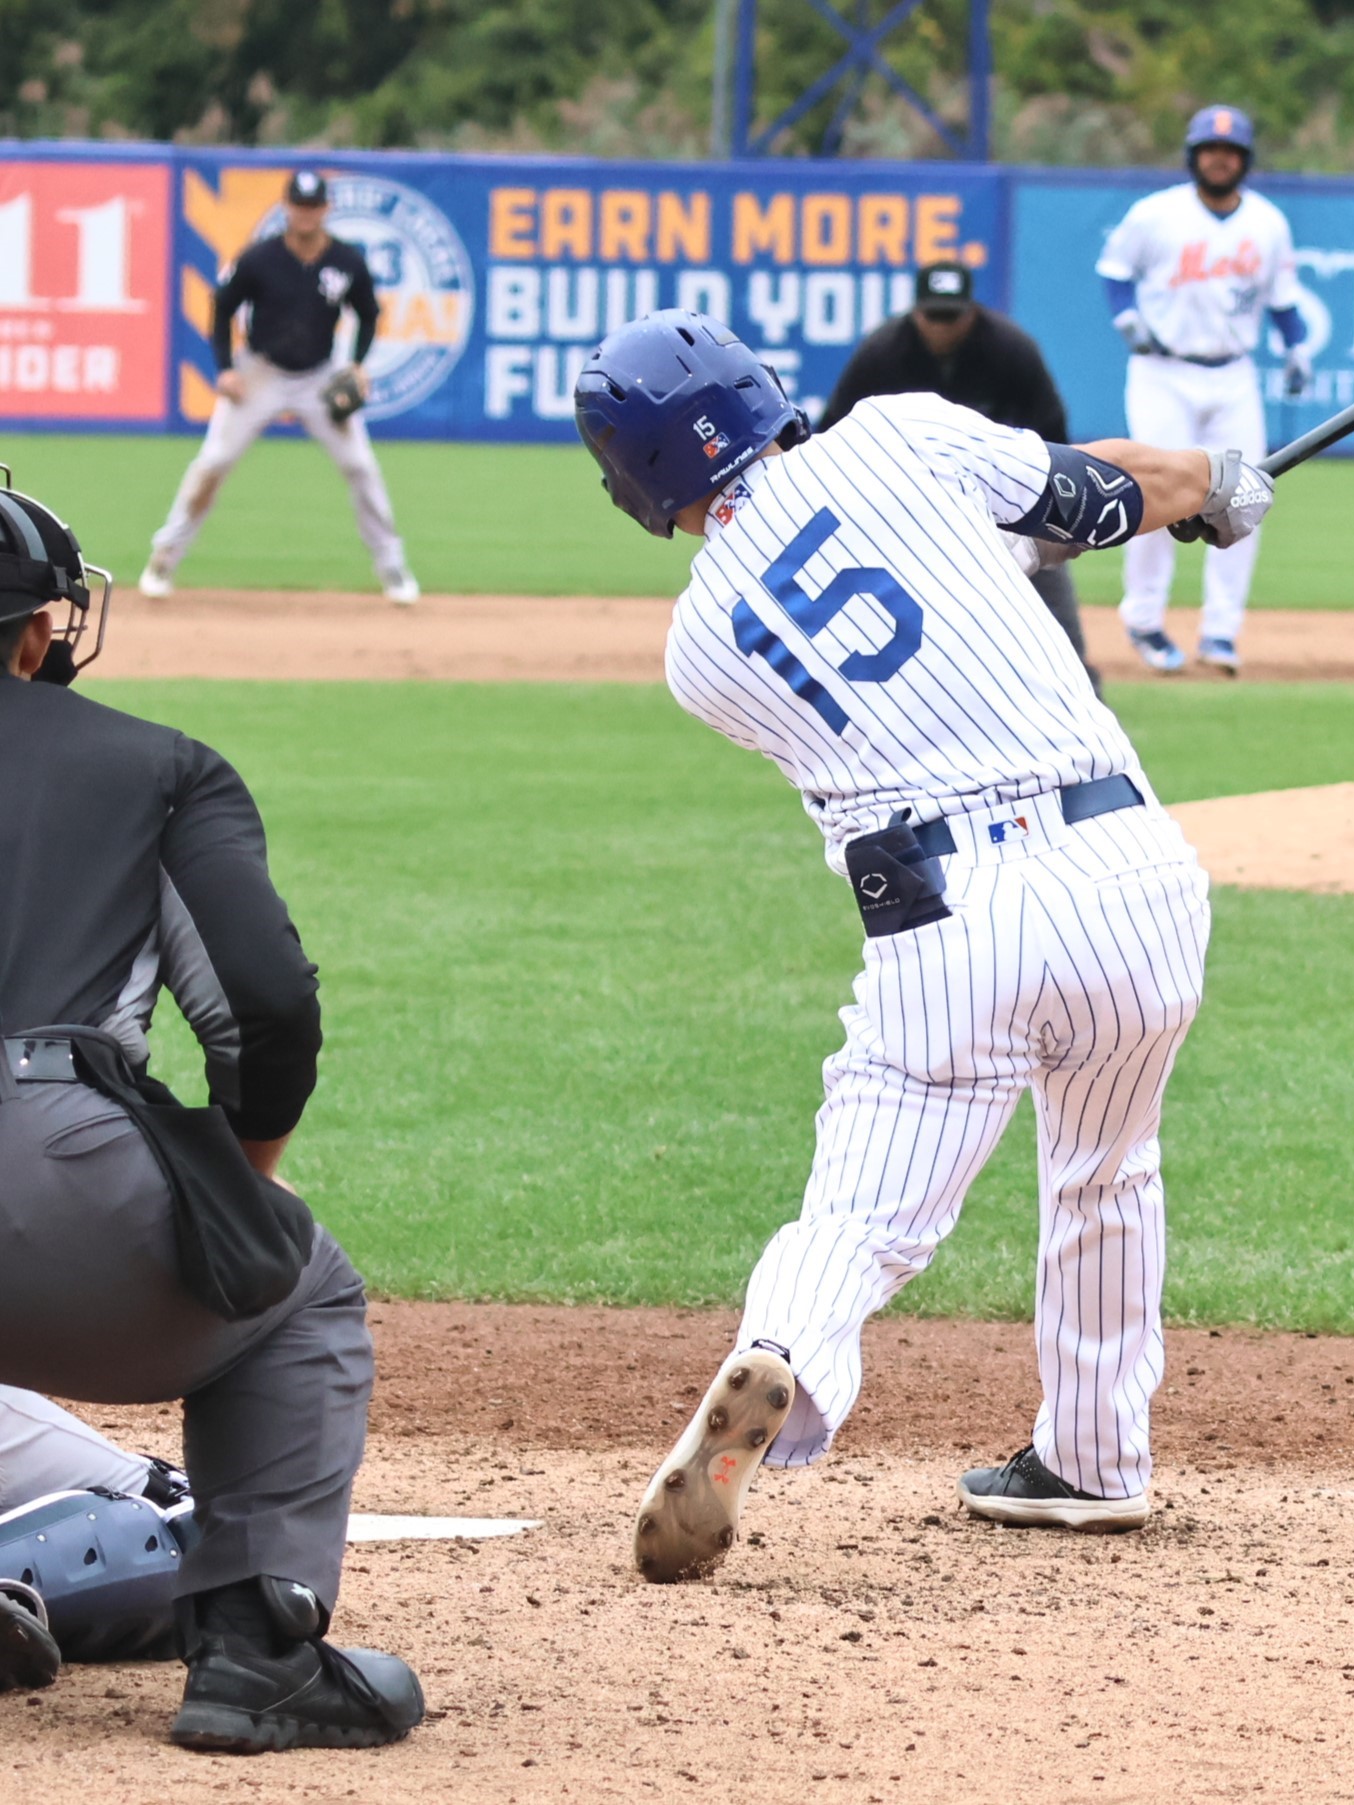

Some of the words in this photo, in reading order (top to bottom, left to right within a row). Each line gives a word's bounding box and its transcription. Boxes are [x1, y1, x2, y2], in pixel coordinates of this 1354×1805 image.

[489, 188, 711, 261] EARN
[732, 193, 987, 266] MORE.
[693, 415, 717, 441] 15
[709, 446, 755, 484] RAWLINGS
[1230, 489, 1269, 508] adidas
[732, 505, 924, 737] 15
